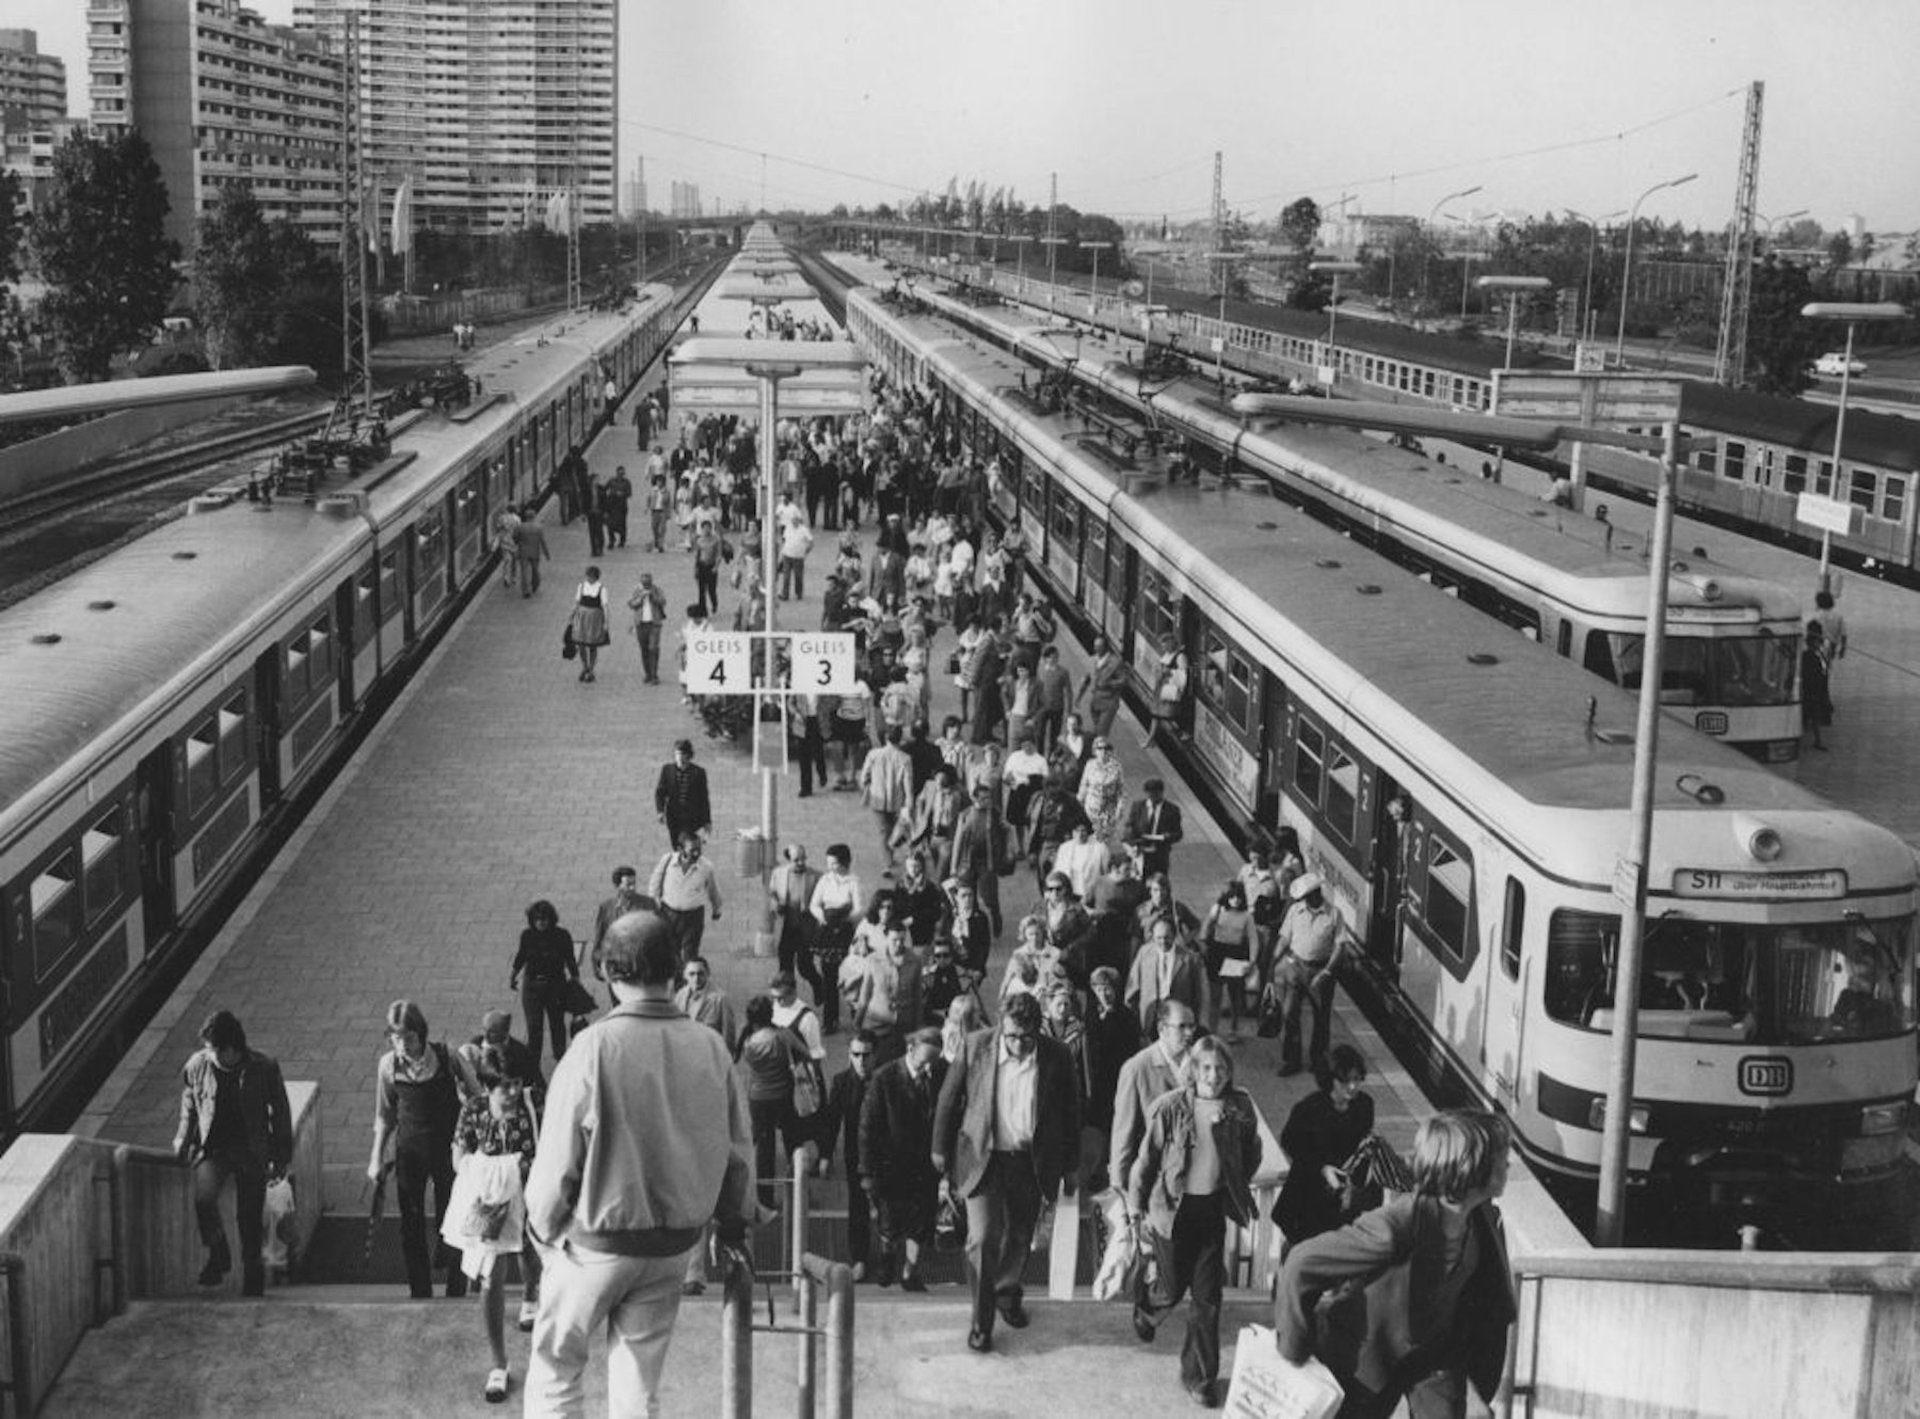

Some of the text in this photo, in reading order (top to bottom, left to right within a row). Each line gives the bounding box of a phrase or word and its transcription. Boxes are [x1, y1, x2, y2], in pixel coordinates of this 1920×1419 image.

[694, 640, 742, 655] GLEIS
[800, 640, 846, 655] GLEIS
[709, 659, 726, 685] 4
[817, 660, 832, 685] 3
[1362, 789, 1369, 811] 2
[1414, 837, 1422, 861] 2
[1691, 871, 1722, 889] S11
